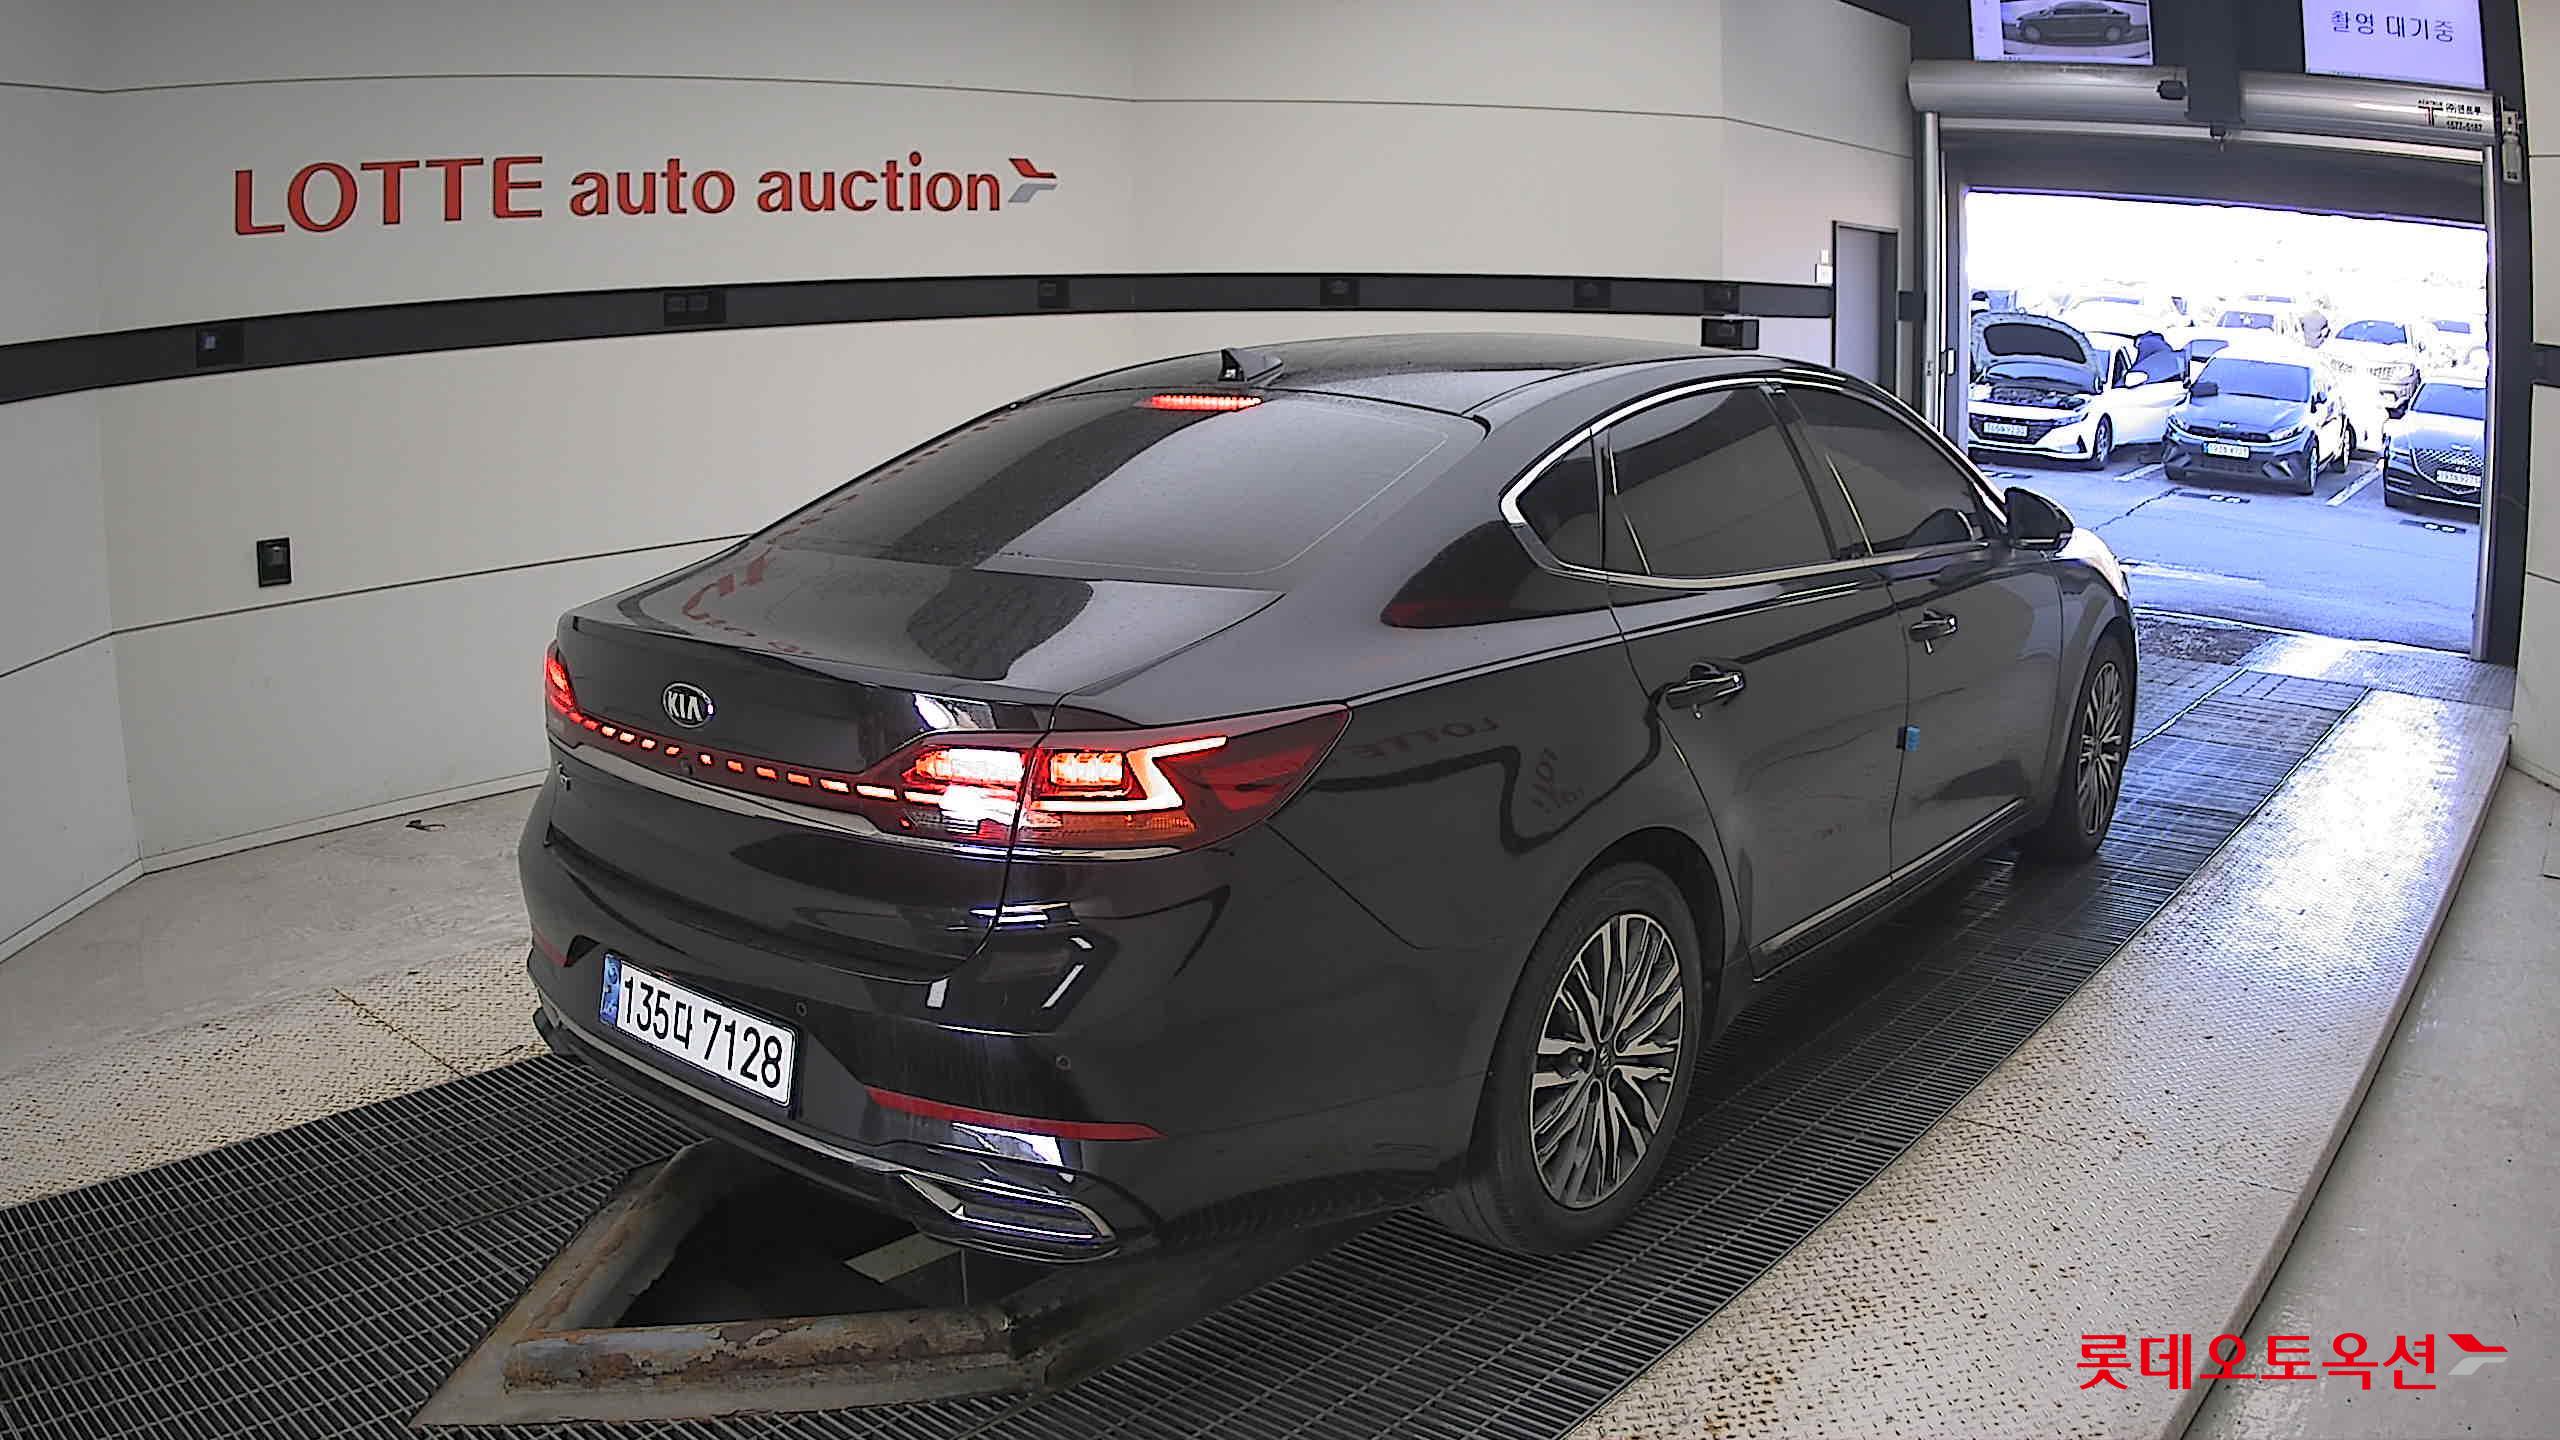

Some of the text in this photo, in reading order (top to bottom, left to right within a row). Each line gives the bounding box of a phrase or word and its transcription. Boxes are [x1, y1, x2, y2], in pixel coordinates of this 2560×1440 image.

[2331, 10, 2375, 36] 촬영
[235, 150, 1001, 236] LOTTE auto auction
[667, 690, 703, 722] KIA
[624, 976, 784, 1089] 135다 7128
